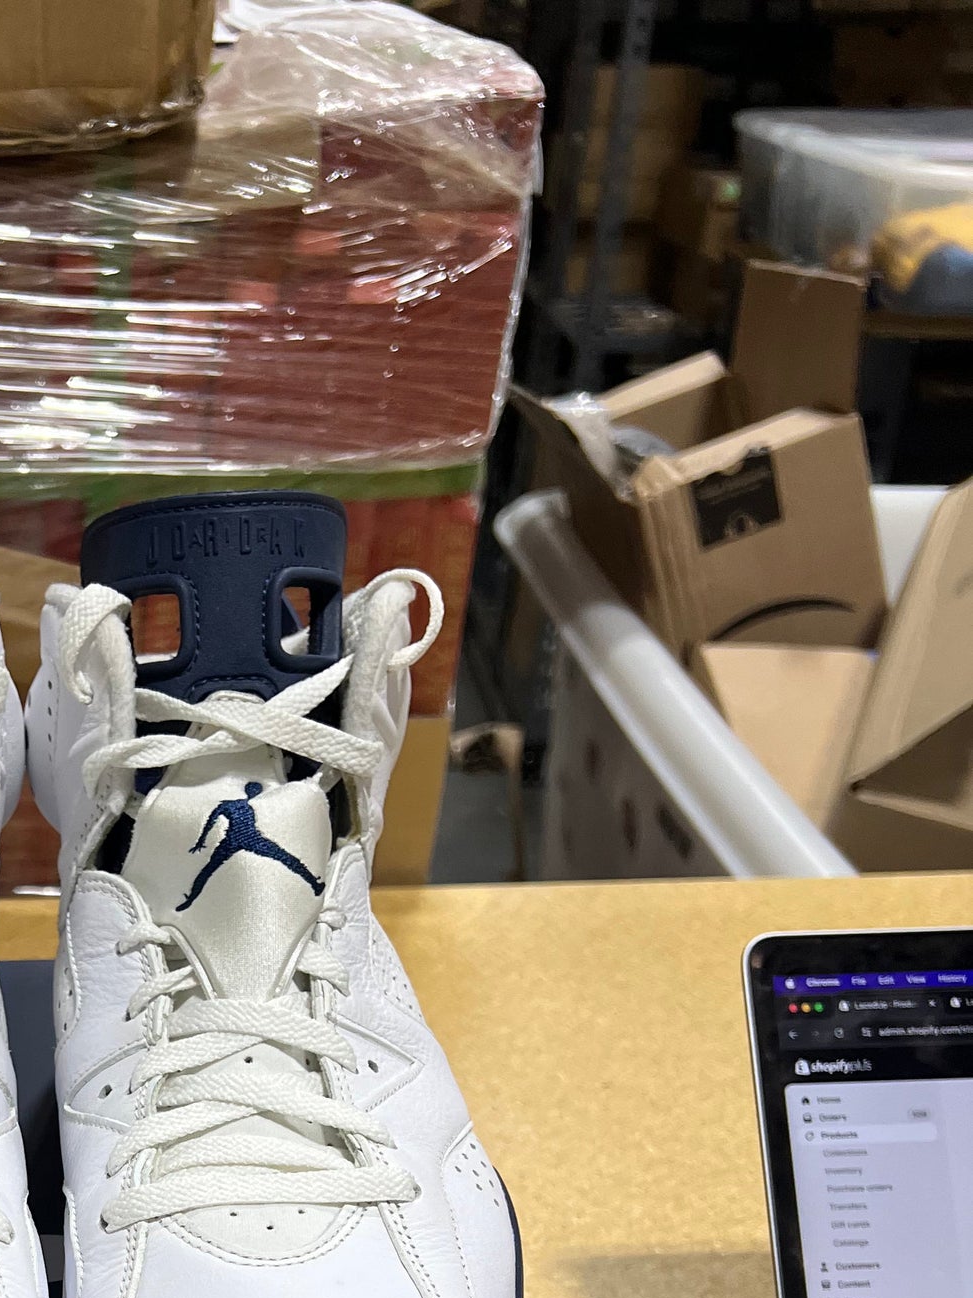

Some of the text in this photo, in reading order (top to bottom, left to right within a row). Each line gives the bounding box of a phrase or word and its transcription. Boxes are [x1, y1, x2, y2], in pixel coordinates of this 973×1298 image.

[805, 973, 968, 988] Chrome File Edit View History
[818, 1112, 847, 1122] Orders
[820, 1130, 859, 1140] Products
[835, 1261, 880, 1271] Customers
[837, 1280, 871, 1289] Content
